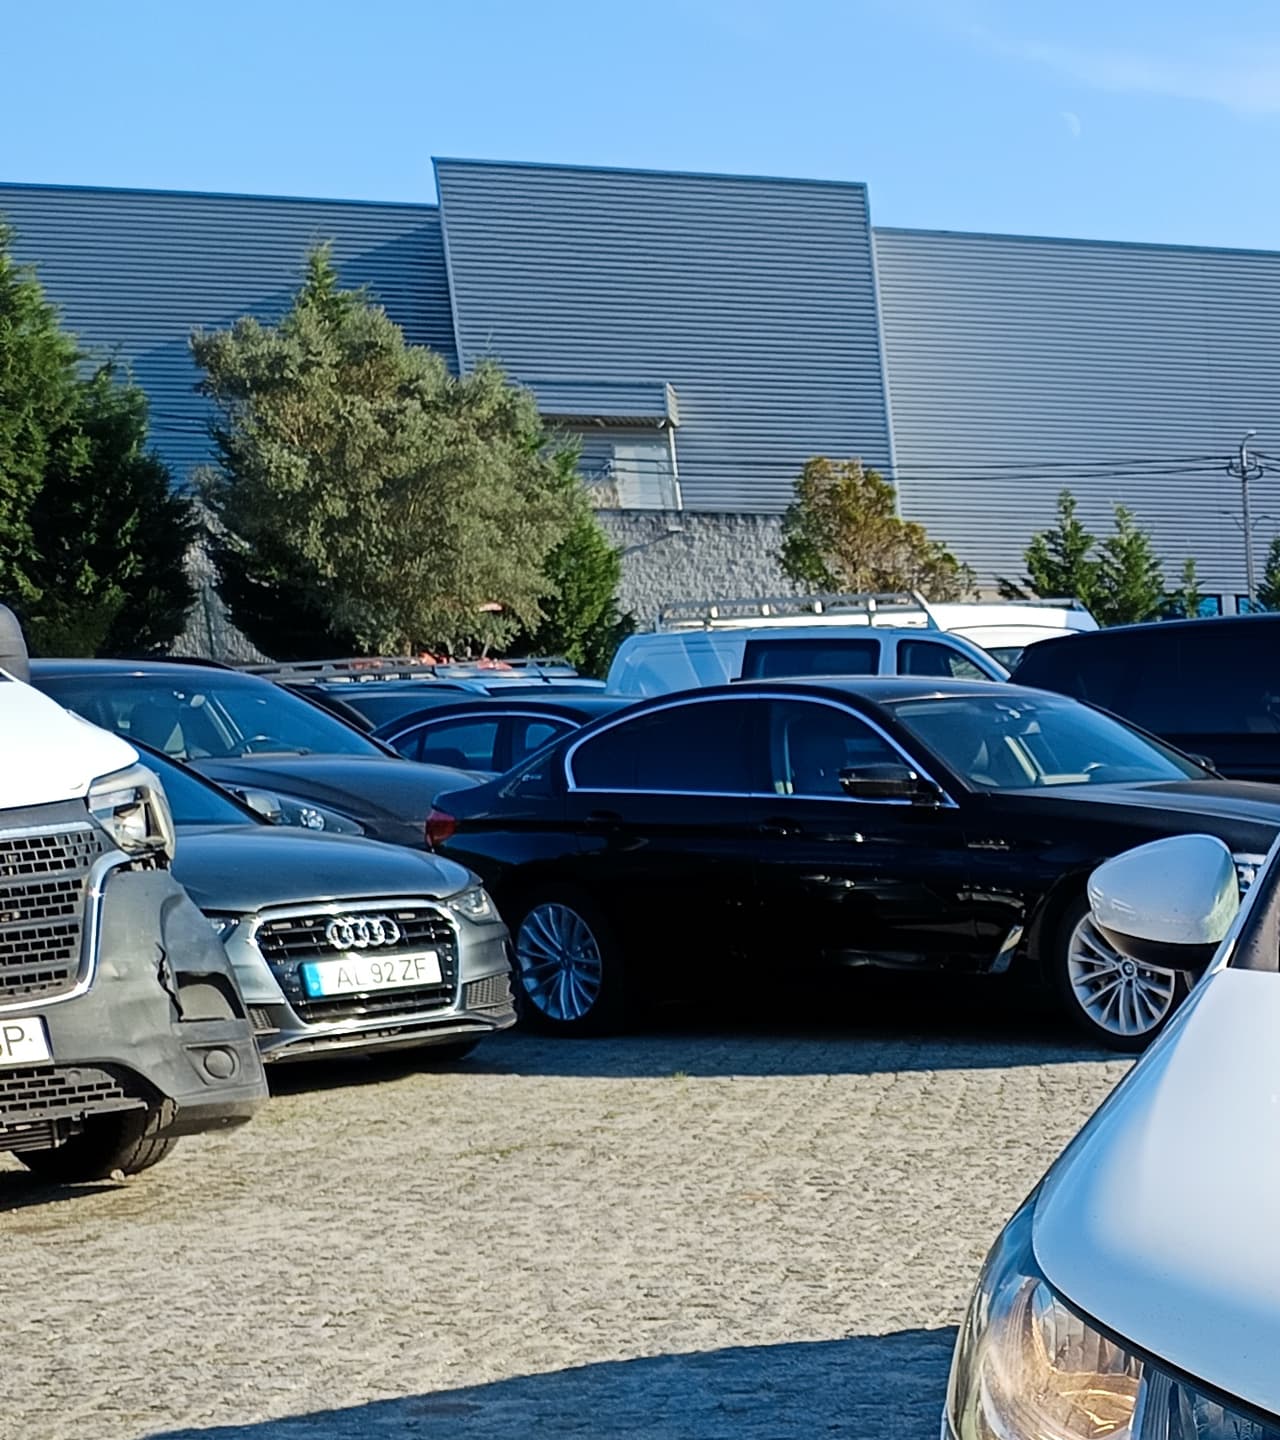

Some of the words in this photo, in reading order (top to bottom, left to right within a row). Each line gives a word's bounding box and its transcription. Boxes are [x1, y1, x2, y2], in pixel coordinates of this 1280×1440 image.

[337, 967, 368, 989] AL
[370, 962, 397, 984] 92
[399, 957, 427, 982] ZF
